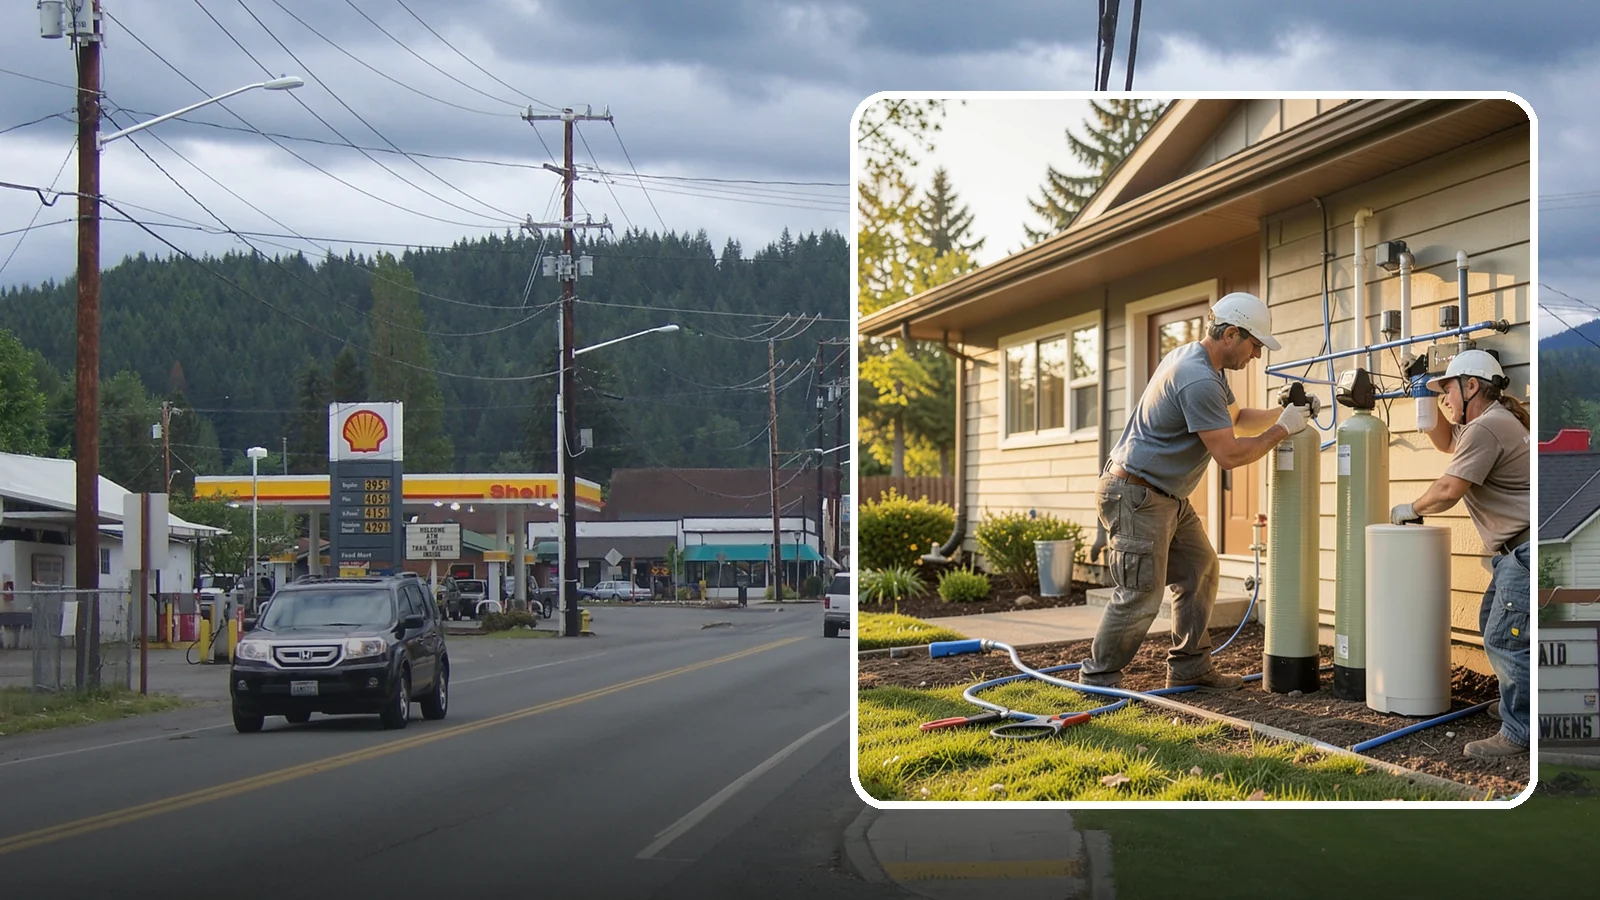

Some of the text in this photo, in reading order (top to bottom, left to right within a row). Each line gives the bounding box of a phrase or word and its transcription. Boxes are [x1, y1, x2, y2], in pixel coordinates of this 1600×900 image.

[365, 480, 383, 490] 395
[490, 484, 547, 499] Shell
[365, 494, 383, 504] 405
[365, 508, 383, 518] 415
[365, 522, 384, 533] 429
